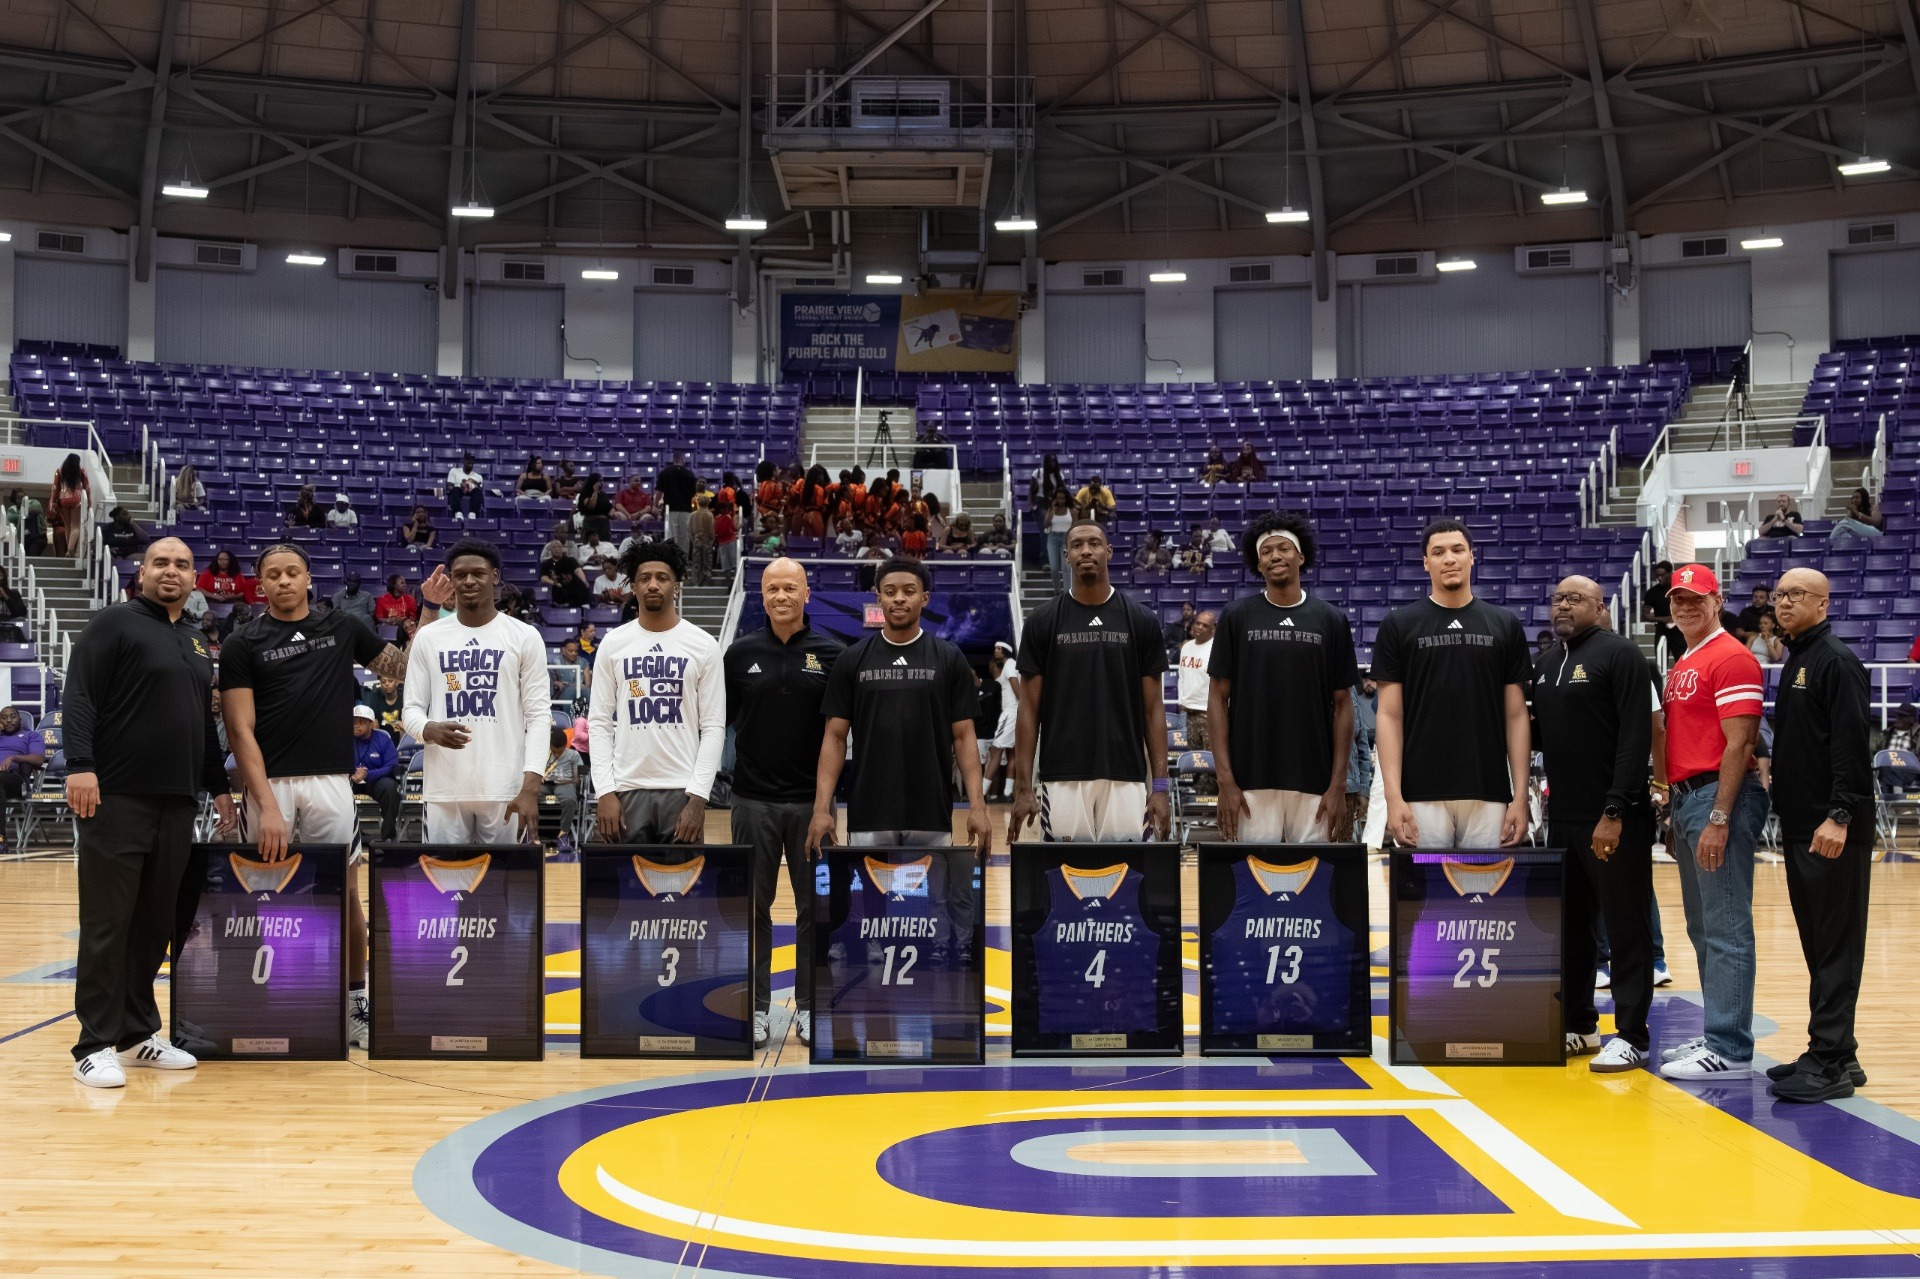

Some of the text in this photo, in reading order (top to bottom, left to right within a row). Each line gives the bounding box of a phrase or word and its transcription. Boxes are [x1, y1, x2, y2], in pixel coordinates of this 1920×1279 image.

[794, 305, 863, 315] PRAIRIE VIEW
[811, 334, 865, 346] ROCK THE
[788, 347, 887, 359] PURPLE AND GOLD
[1057, 631, 1129, 644] PRAIRIE VIEW
[1247, 630, 1292, 641] PRAIRIE
[1418, 633, 1494, 649] PRAIRIE VIEW
[262, 635, 336, 661] PRAIRIE VIEW
[438, 648, 506, 673] LEGACY
[623, 655, 689, 680] LEGACY
[469, 674, 495, 687] ON
[860, 668, 936, 682] PRAIRIE VIEW
[652, 682, 680, 694] ON
[445, 690, 498, 718] LOCK
[628, 697, 684, 725] LOCK
[224, 916, 303, 938] PANTHERS
[417, 917, 497, 939] PANTHERS
[629, 918, 708, 940] PANTHERS
[860, 916, 938, 939] PANTHERS
[1056, 921, 1134, 943] PANTHERS
[1245, 917, 1322, 938] PANTHERS
[1436, 919, 1517, 941] PANTHERS
[251, 944, 275, 985] 0
[445, 945, 469, 986] 2
[657, 947, 680, 987] 3
[881, 945, 918, 985] 12
[1084, 949, 1107, 988] 4
[1265, 945, 1304, 984] 13
[1453, 948, 1501, 988] 25
